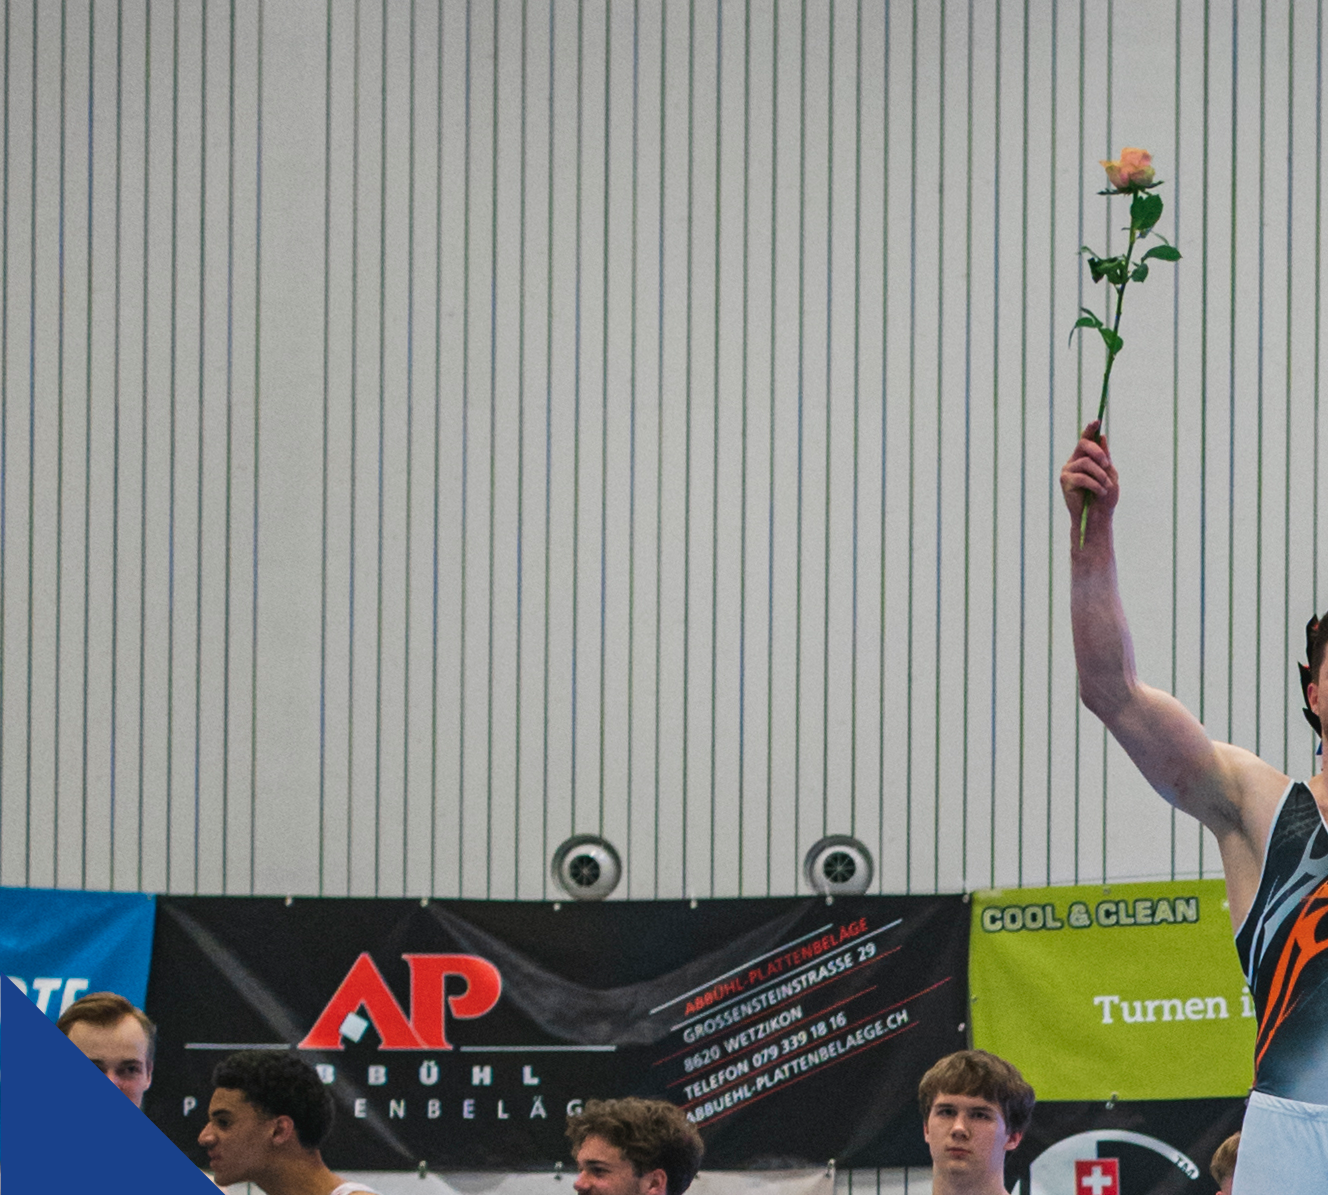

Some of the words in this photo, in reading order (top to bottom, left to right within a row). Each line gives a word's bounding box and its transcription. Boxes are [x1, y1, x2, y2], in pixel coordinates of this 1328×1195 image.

[981, 903, 1064, 933] COOL
[1067, 901, 1092, 929] &
[1096, 897, 1200, 927] CLEAN
[297, 953, 502, 1050] AP
[683, 951, 854, 1044] GROSSENSTEINSTRASSE
[857, 942, 877, 963] 29
[684, 917, 869, 1017] ABBÜHL-PLATTENBELÄGE
[684, 1044, 721, 1073] 8620
[723, 1005, 803, 1054] WETZIKON
[1093, 995, 1229, 1025] Turnen
[315, 1061, 540, 1086] BBÜHL
[684, 1059, 750, 1101] TELEFON
[752, 1044, 780, 1068] 079
[781, 1032, 808, 1055] 339
[810, 1020, 828, 1040] 18
[829, 1011, 848, 1031] 16
